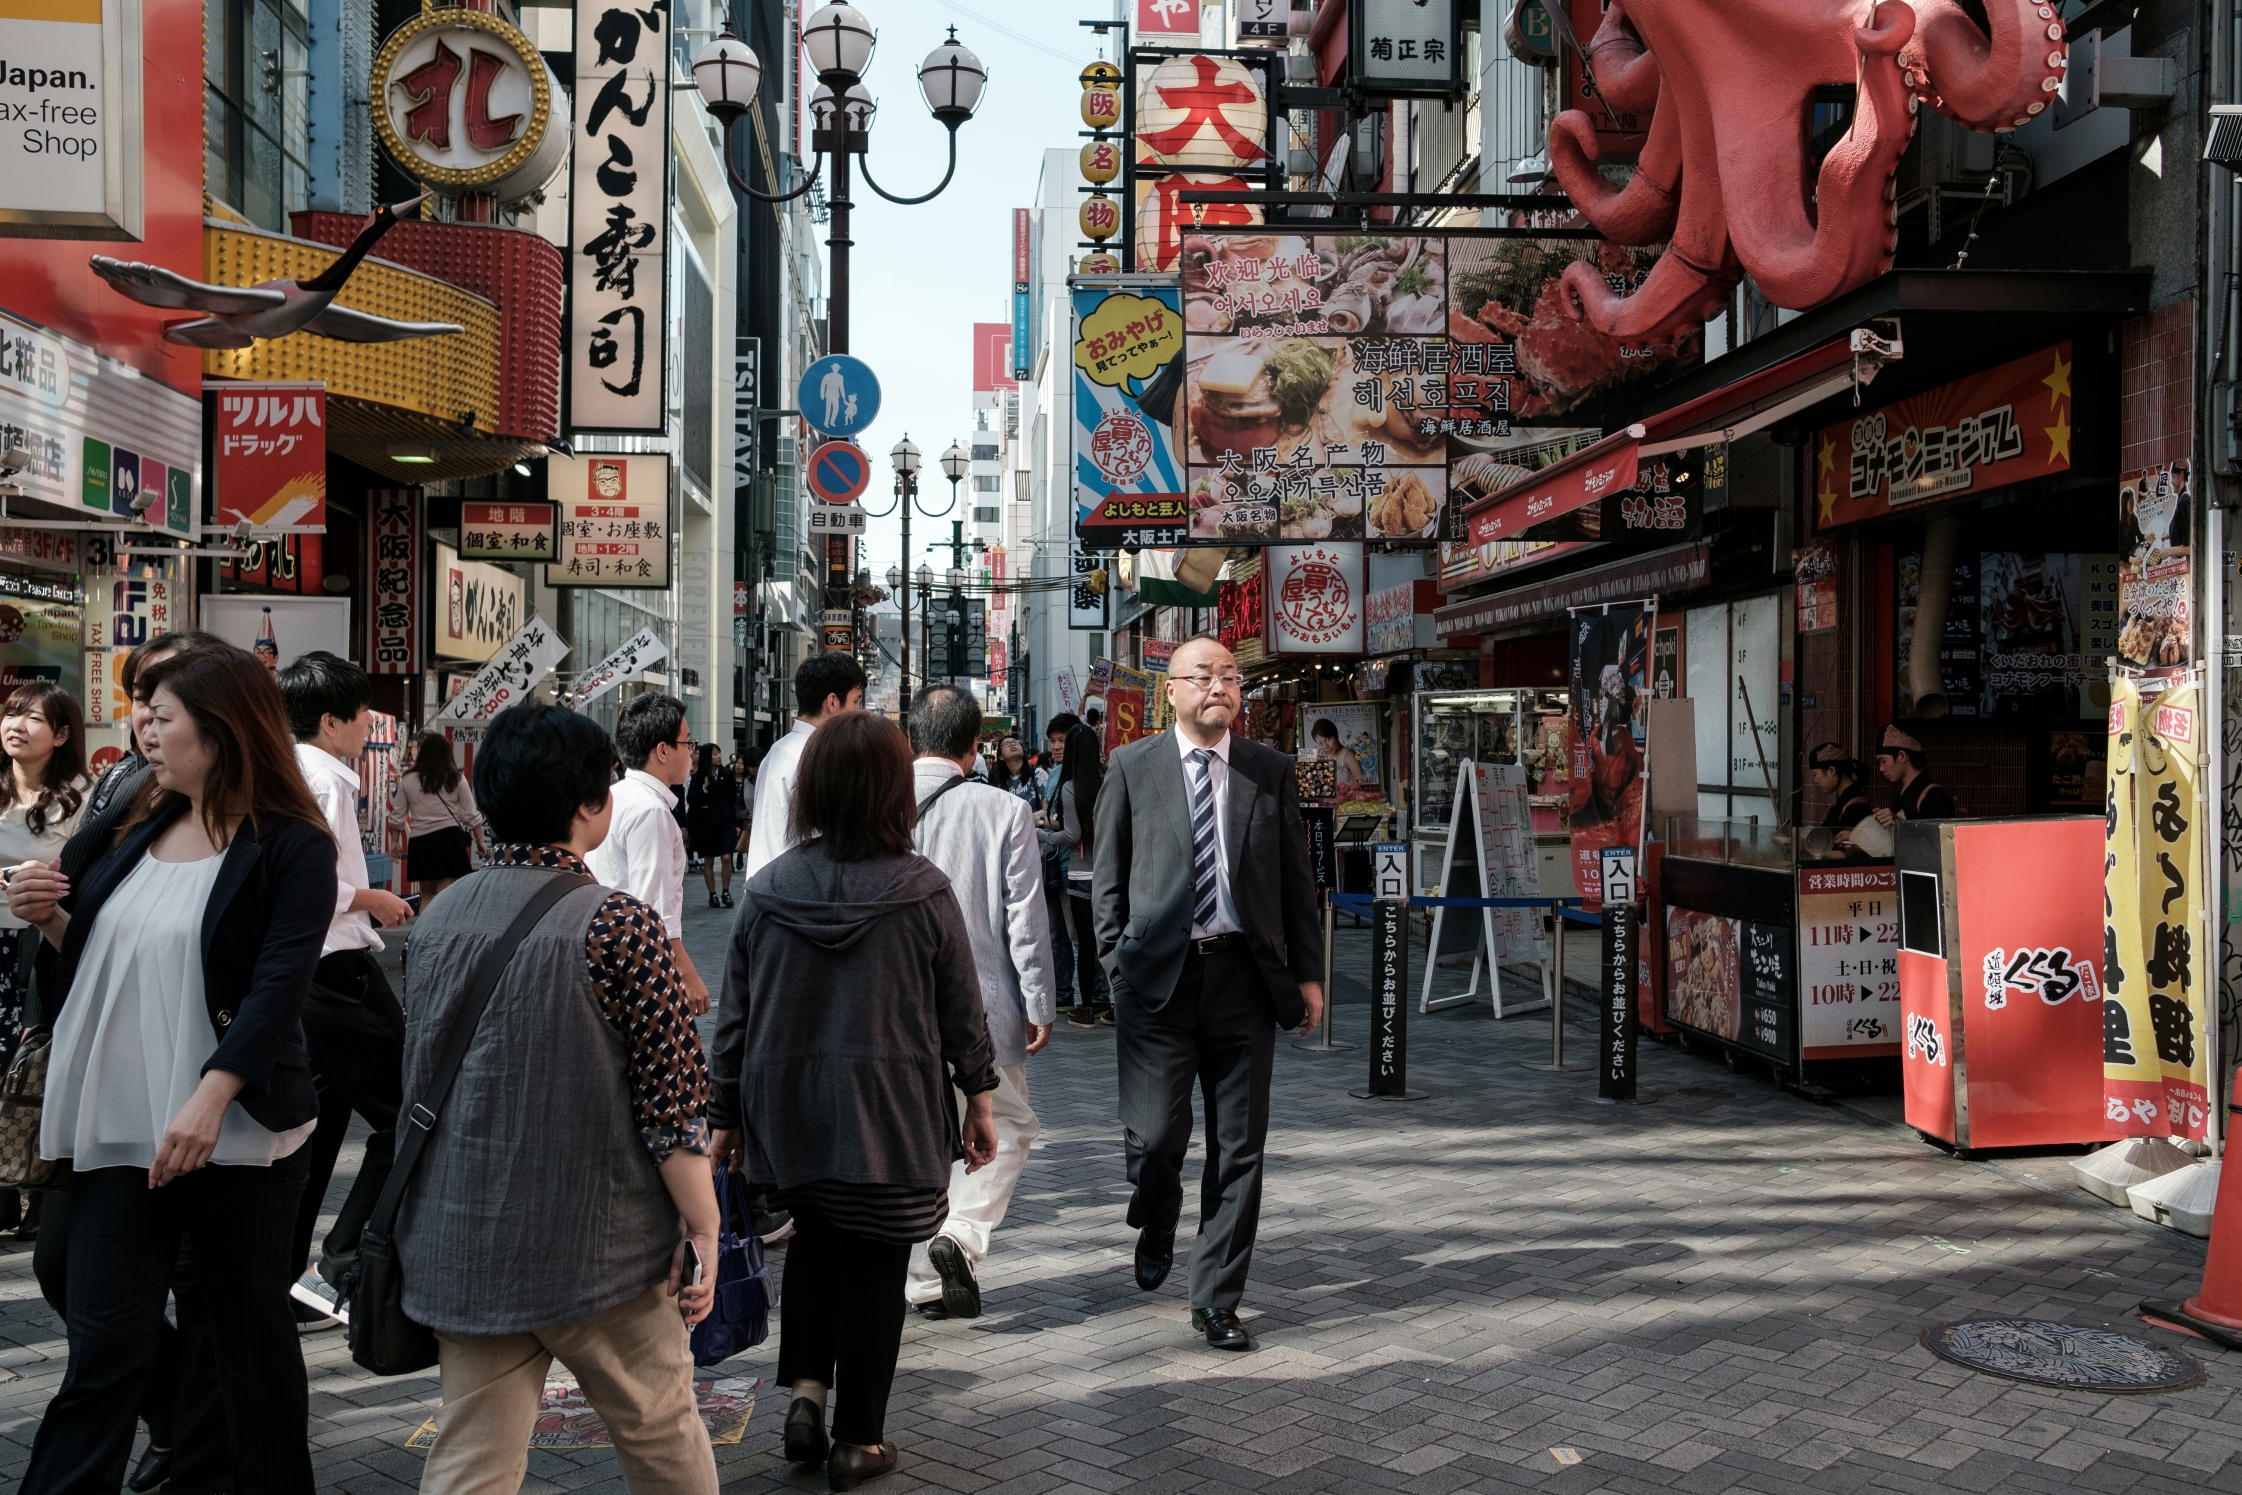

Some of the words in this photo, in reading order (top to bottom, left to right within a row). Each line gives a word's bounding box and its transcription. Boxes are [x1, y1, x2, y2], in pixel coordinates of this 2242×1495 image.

[1527, 7, 1549, 37] B
[1370, 37, 1445, 63] 菊正宗
[23, 129, 97, 161] Shop
[1204, 253, 1321, 288] 欢迎光临
[1016, 283, 1028, 293] 8F
[1213, 288, 1326, 319] 어서오세요
[1086, 308, 1164, 360] おみやげ
[1240, 320, 1329, 339] いらっしゃいませ
[1016, 370, 1027, 380] 7F
[1353, 378, 1511, 413] 해선호프집
[223, 396, 321, 427] ツルハ
[735, 350, 754, 489] TSUTAYA
[1102, 408, 1143, 420] よしもと
[1420, 419, 1511, 436] 海鮮居酒屋
[224, 434, 302, 456] ドラッグ
[1850, 404, 2022, 498] コナモンミュージアム
[1216, 440, 1386, 475] 大阪名产物
[1220, 472, 1387, 505] 오오사까특산품
[170, 511, 188, 525] SOFINA
[488, 507, 525, 524] 地階
[590, 506, 625, 517] 3・4階
[812, 512, 864, 528] 自動車
[1104, 502, 1187, 517] よしもと芸人
[1221, 509, 1278, 524] 大阪名物
[1621, 496, 1687, 530] 物語
[464, 531, 550, 551] 個室・和食
[566, 557, 652, 577] 寿司・和食
[1290, 549, 1340, 566] よしもと
[376, 499, 411, 664] 大阪紀念品
[2123, 579, 2187, 601] 自分流のたこ焼を
[36, 619, 78, 630] Tax-free
[41, 608, 78, 619] Japan.
[1738, 614, 1746, 627] 4F
[51, 632, 78, 642] Shop
[91, 622, 102, 645] TAX
[1274, 610, 1358, 644] なにわおもろいもん
[1738, 650, 1746, 663] 3F
[91, 653, 102, 688] FREE
[91, 689, 102, 722] SHOP
[1009, 694, 1017, 706] BAR
[1332, 706, 1374, 715] MESSAGE
[1738, 722, 1746, 735] 1F
[1314, 819, 1326, 883] 本日のサービス
[1381, 854, 1402, 896] 入口
[1608, 859, 1630, 900] 入口
[1847, 901, 1882, 917] 平日
[1809, 924, 1854, 946] 11時
[2003, 951, 2080, 1002] くくる
[1381, 906, 1398, 1077] こちらからお並びください
[1611, 911, 1626, 1081] こちらからお並びください
[1810, 983, 1856, 1006] 10時
[1760, 1007, 1776, 1026] ¥650
[1760, 1027, 1776, 1045] ¥900
